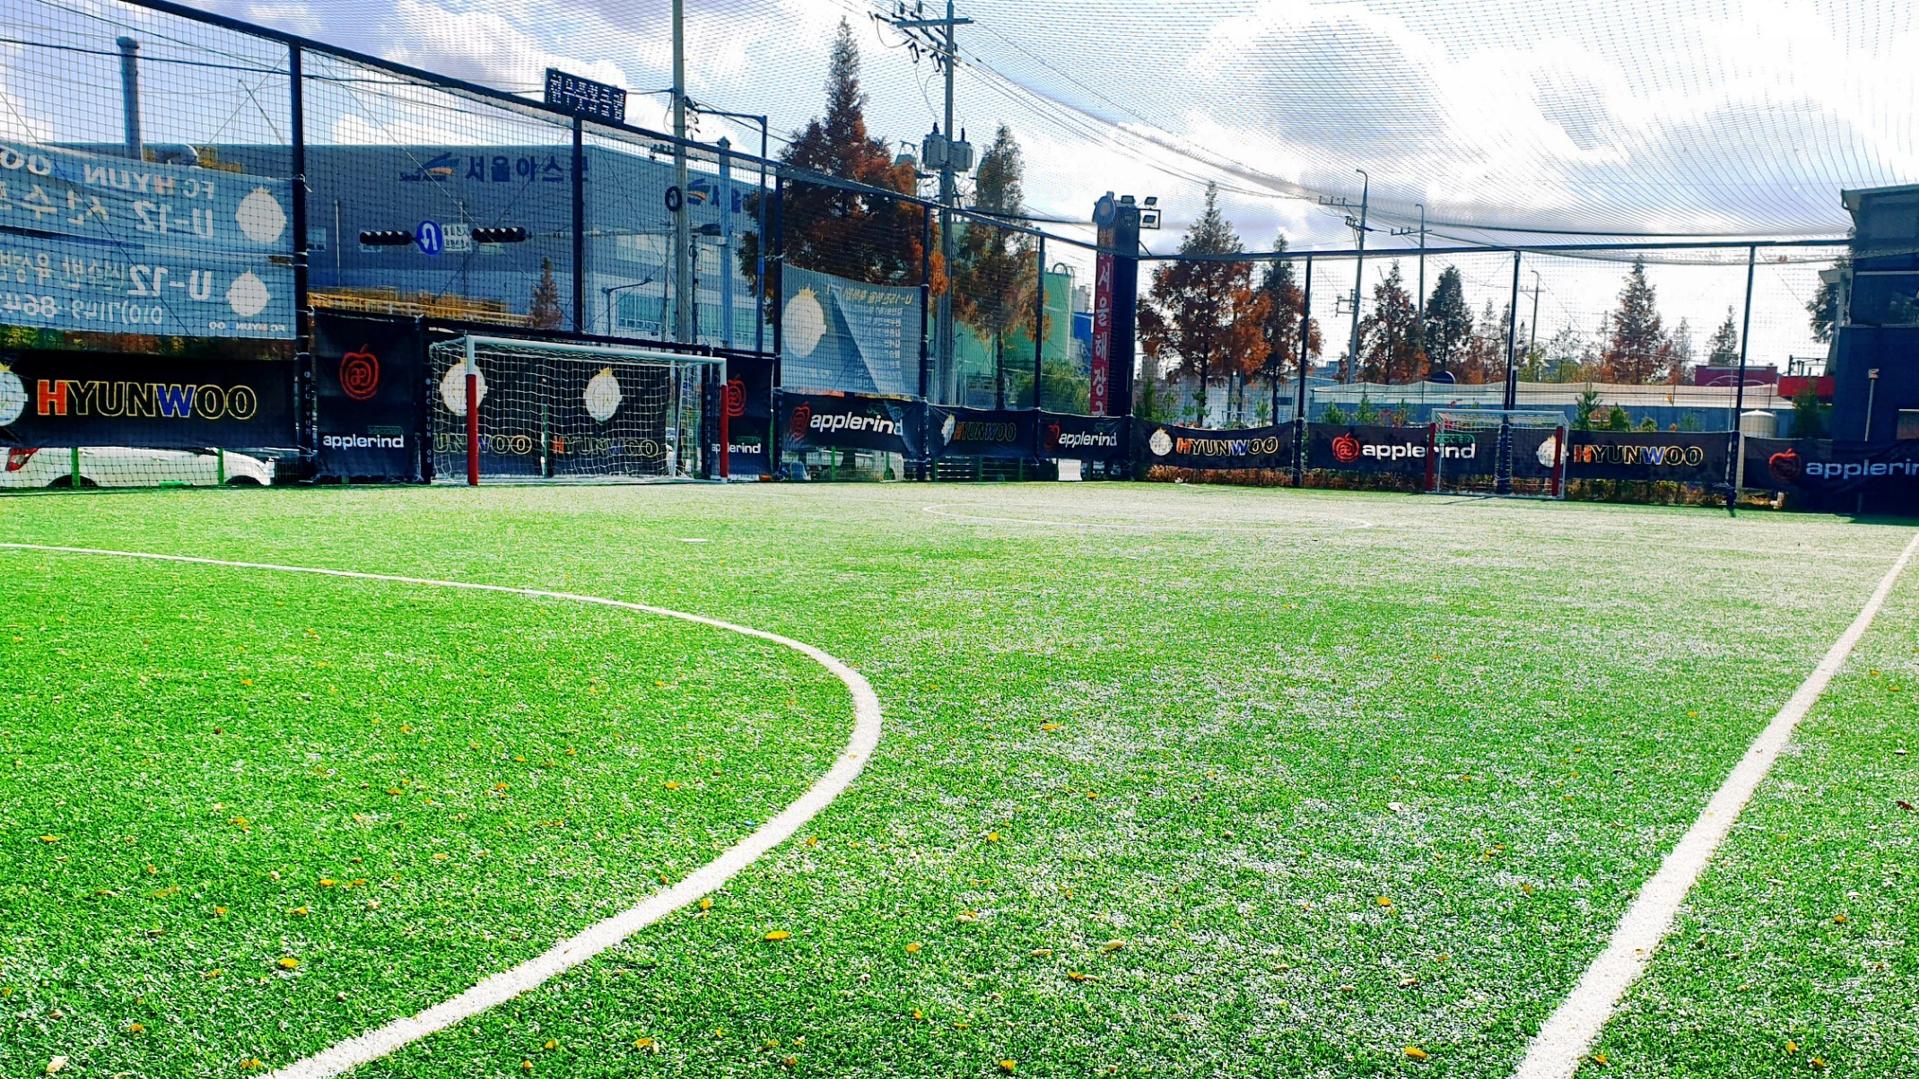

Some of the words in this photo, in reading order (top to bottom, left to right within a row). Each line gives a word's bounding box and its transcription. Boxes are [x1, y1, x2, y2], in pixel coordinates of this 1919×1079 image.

[37, 379, 257, 420] HYUNWOO
[810, 411, 904, 436] applerind
[323, 434, 404, 451] applerind
[712, 442, 761, 455] aplerind
[1058, 432, 1117, 448] applerind
[1176, 434, 1279, 457] HYUNWOO
[1573, 444, 1704, 467] HYUNWOO
